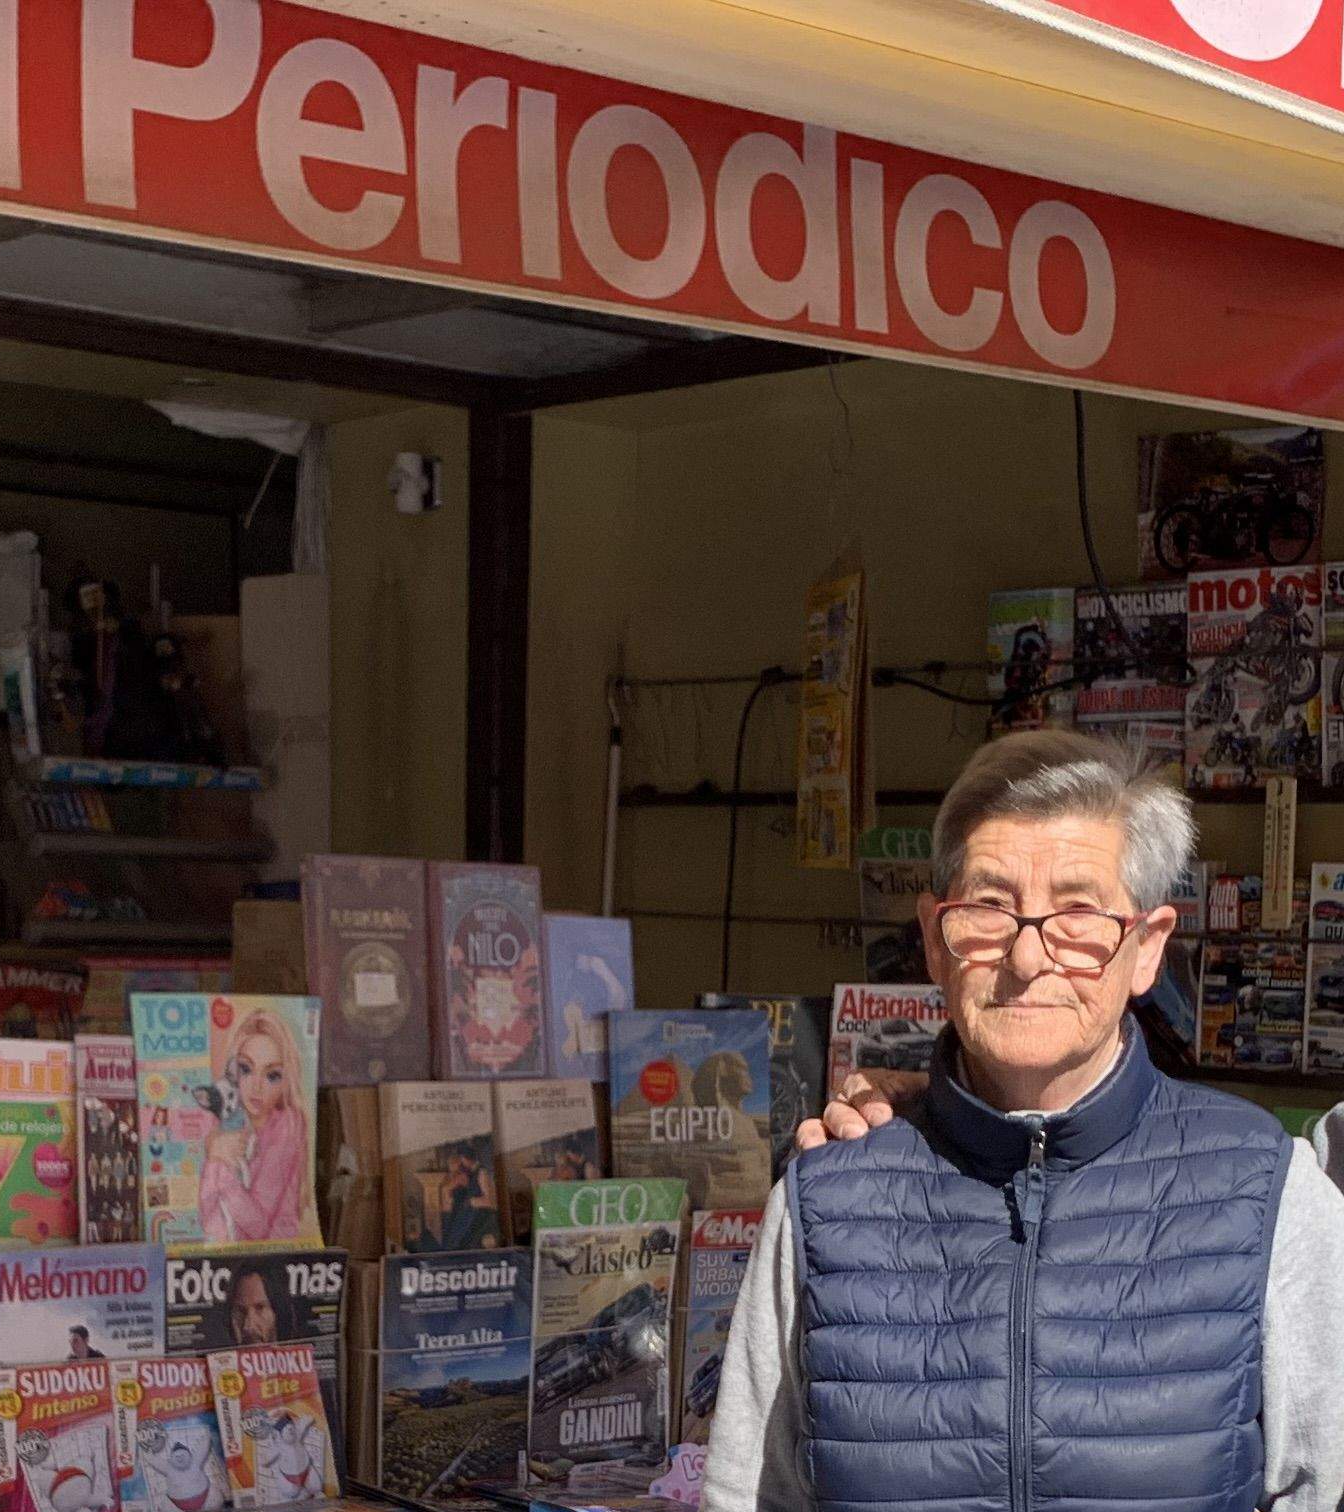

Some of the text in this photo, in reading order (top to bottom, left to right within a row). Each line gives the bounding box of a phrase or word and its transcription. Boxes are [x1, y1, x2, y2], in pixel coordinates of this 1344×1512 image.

[1189, 566, 1323, 613] motos
[1327, 721, 1344, 742] El
[144, 999, 206, 1030] TOP
[650, 1105, 734, 1143] EGIPTO
[569, 1182, 648, 1228] GEO
[696, 1253, 730, 1268] SUV
[399, 1260, 518, 1296] Descobrir
[240, 1349, 313, 1378] SUDOKU
[18, 1365, 106, 1398] SUDOKU
[32, 1394, 99, 1421] Intenso
[558, 1401, 643, 1446] GANDINI
